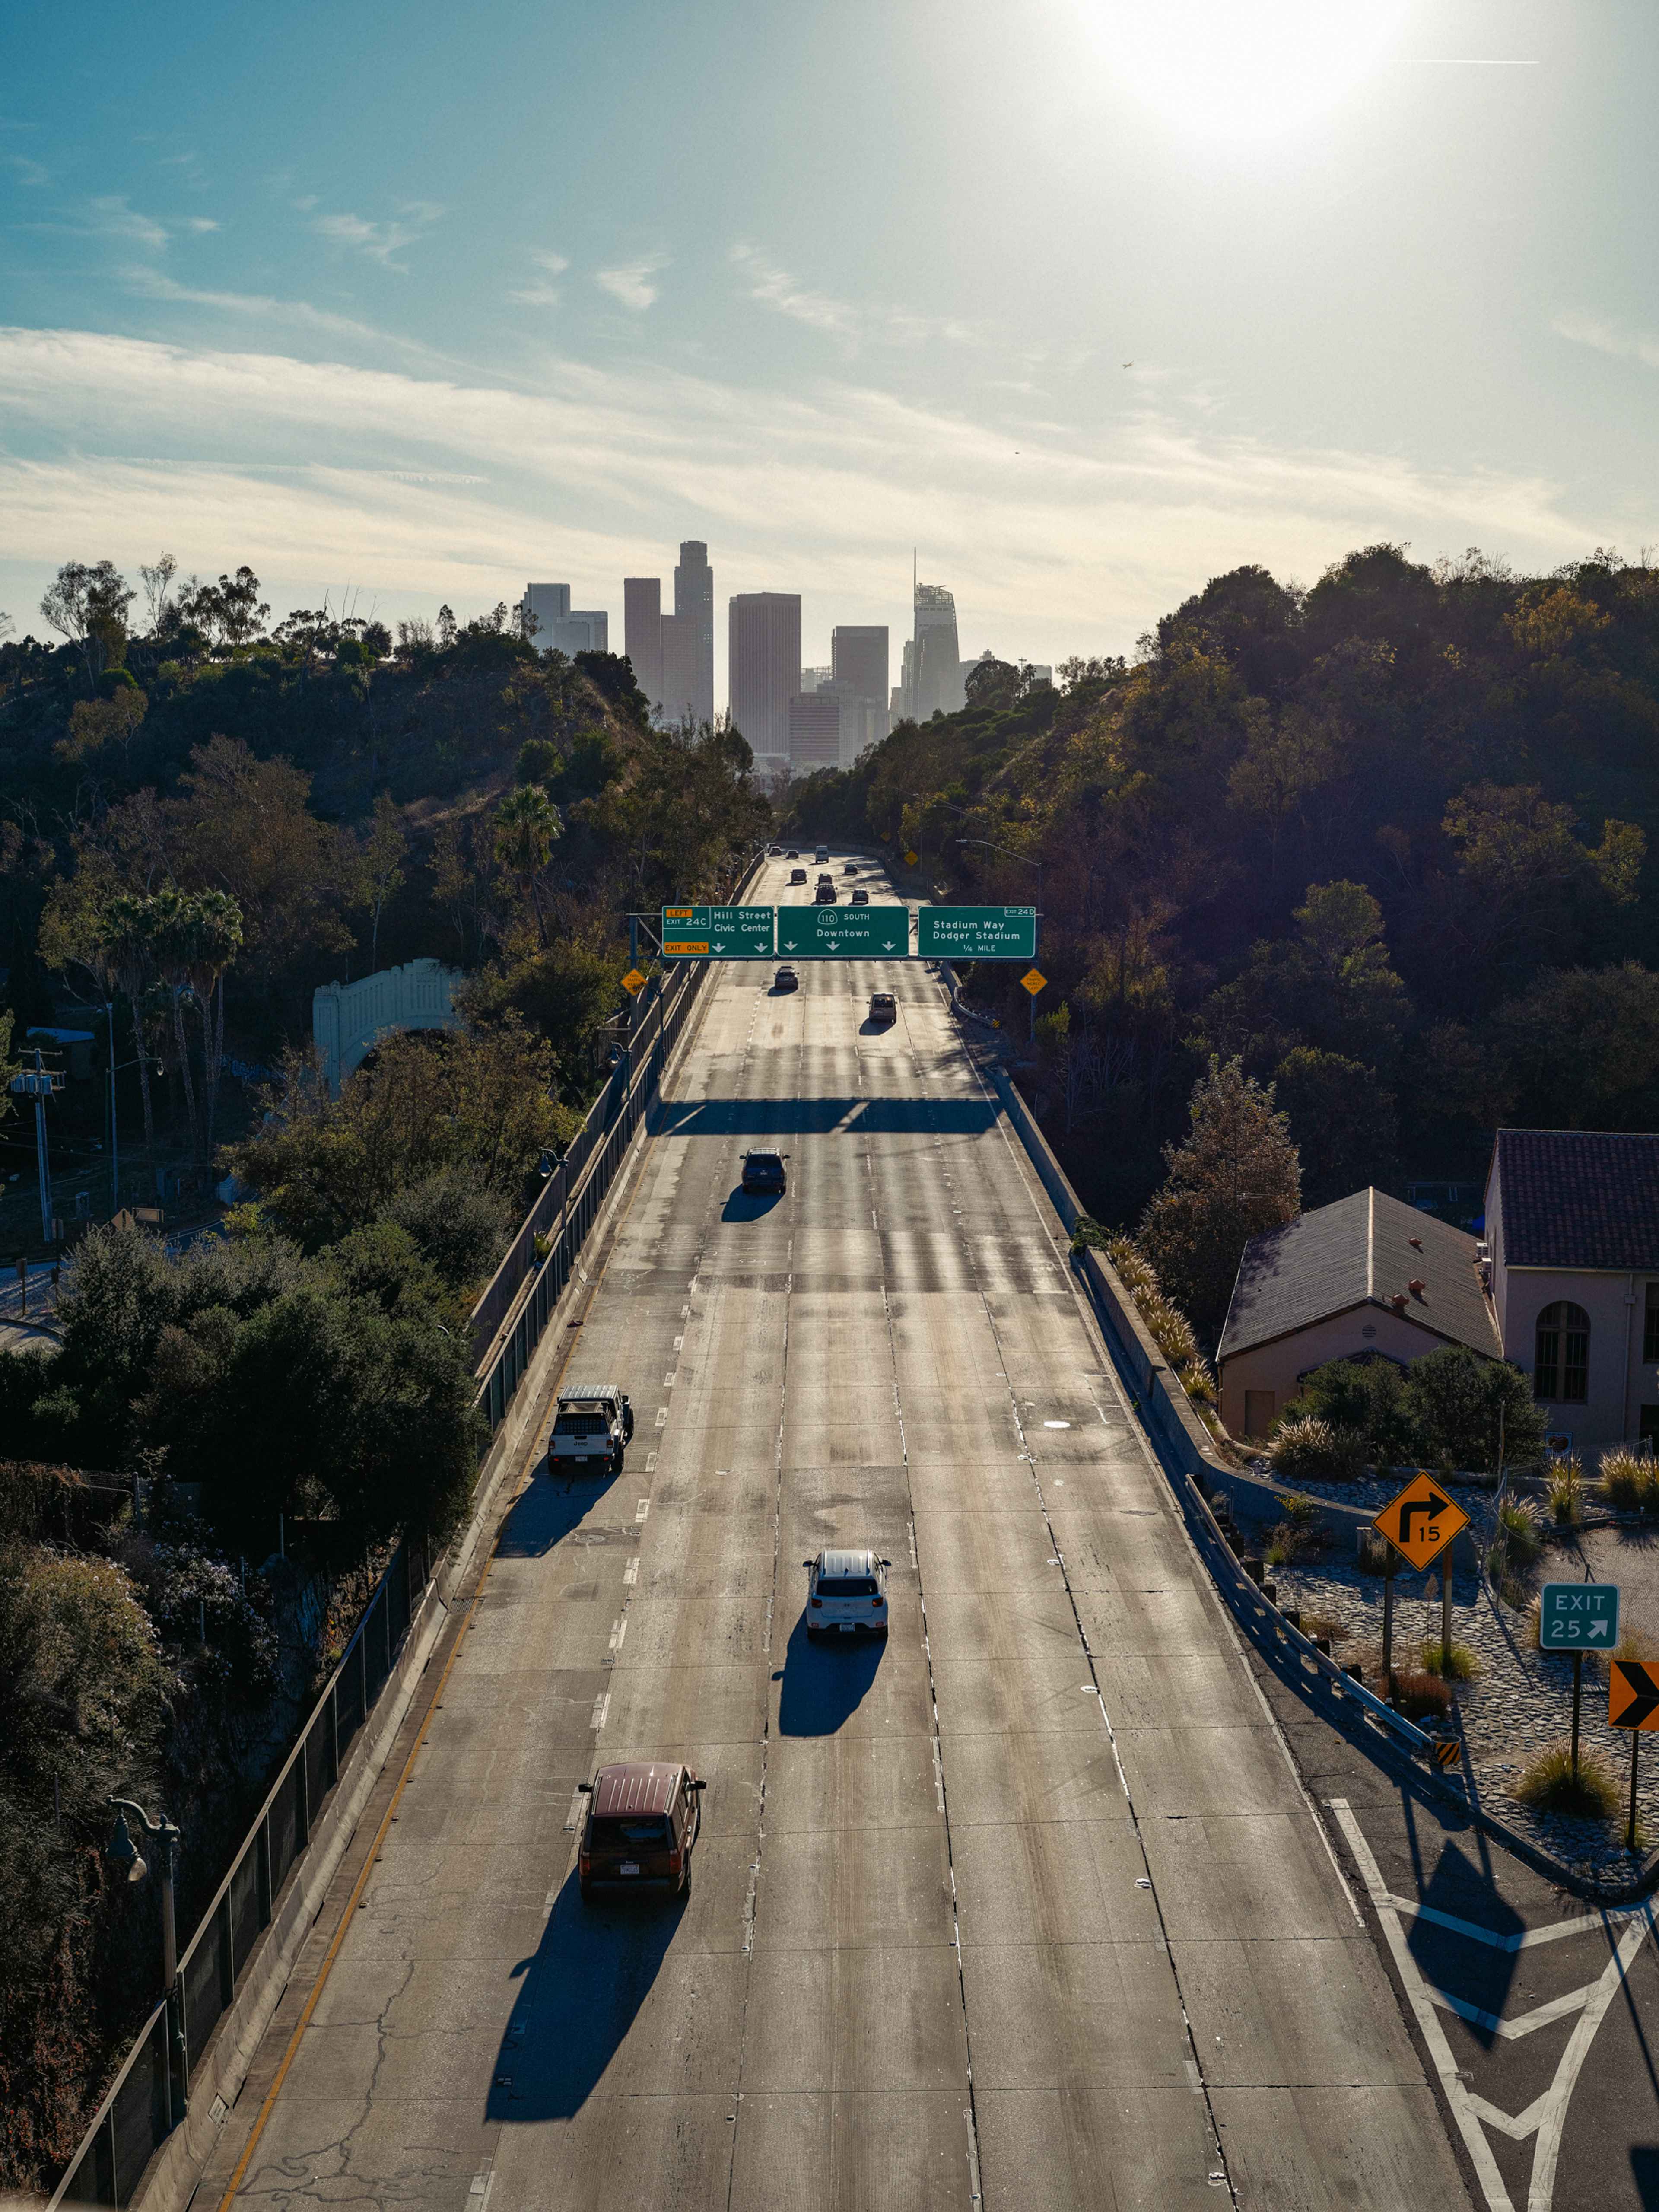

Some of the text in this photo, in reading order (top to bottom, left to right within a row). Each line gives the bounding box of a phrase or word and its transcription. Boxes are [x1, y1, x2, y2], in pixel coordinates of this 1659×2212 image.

[983, 921, 1005, 930] Way
[933, 931, 1020, 941] Dodger Stadium
[1419, 1526, 1440, 1542] 15
[1556, 1595, 1605, 1610] EXIT
[1551, 1620, 1580, 1638] 25
